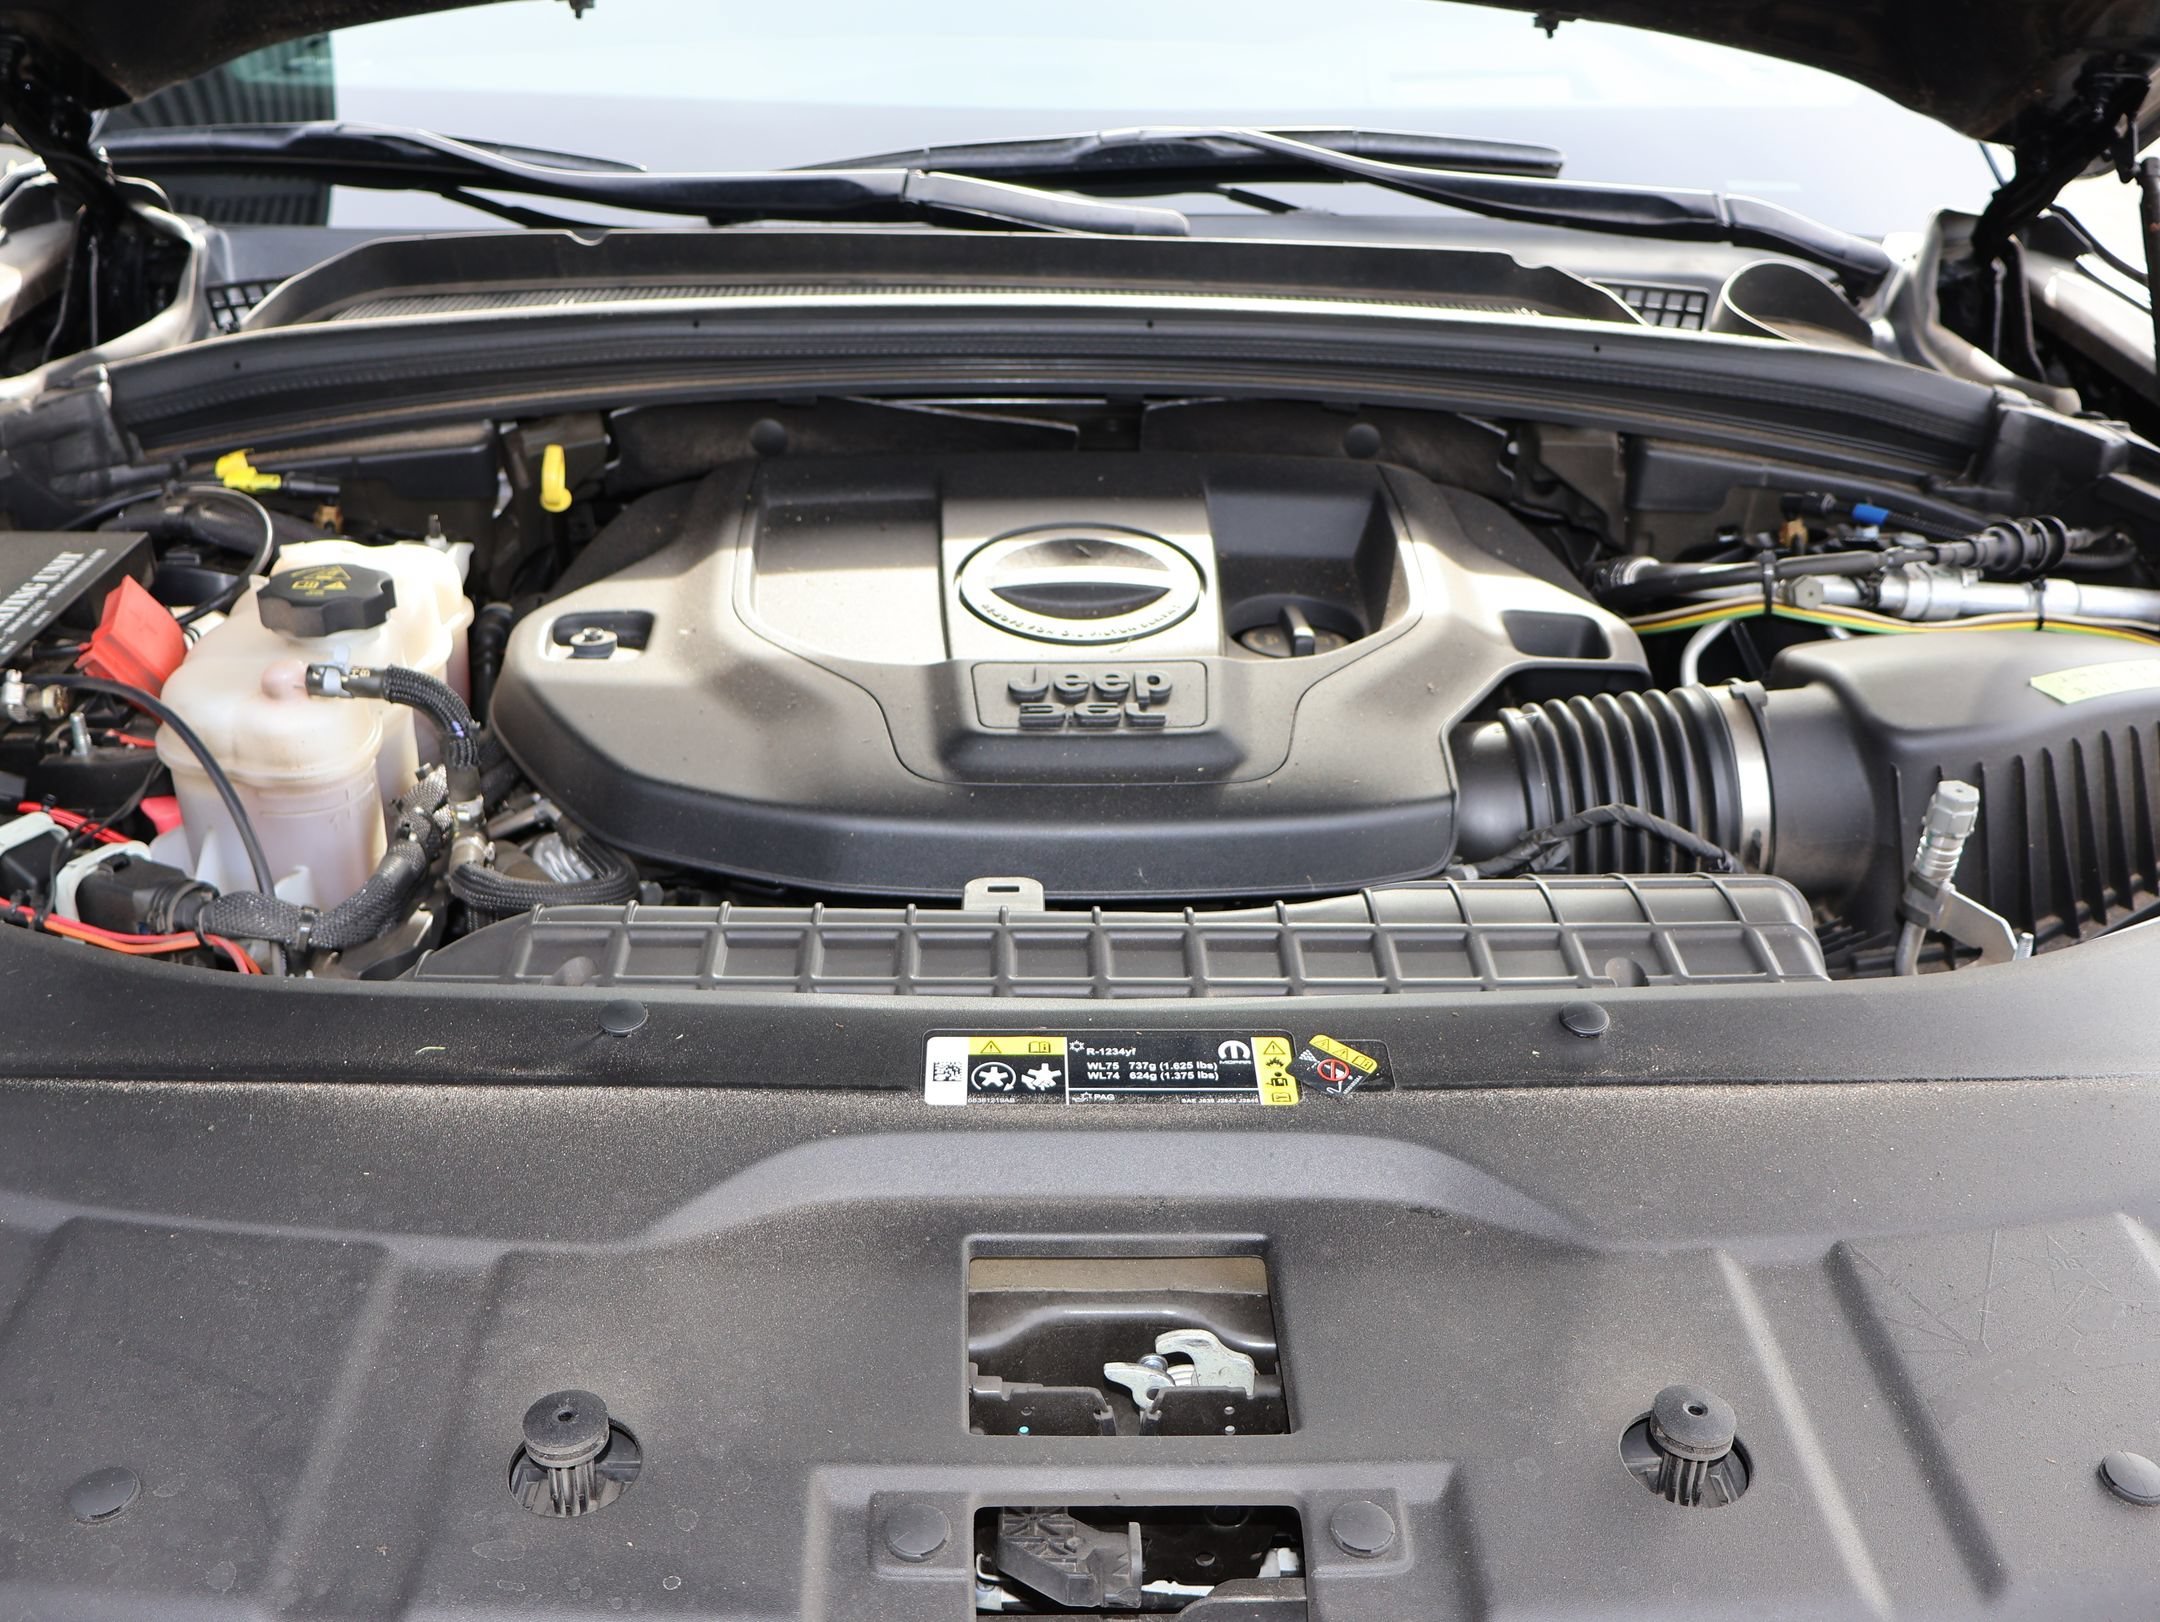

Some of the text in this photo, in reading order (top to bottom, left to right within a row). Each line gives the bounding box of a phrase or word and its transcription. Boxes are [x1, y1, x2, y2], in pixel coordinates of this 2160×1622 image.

[1007, 667, 1172, 709] Jeep
[1086, 1047, 1137, 1057] R-1234yf
[1087, 1061, 1218, 1071] WL75 737g (1.625 lbs)
[1087, 1071, 1219, 1081] WL74 624g (1.375 lbs)
